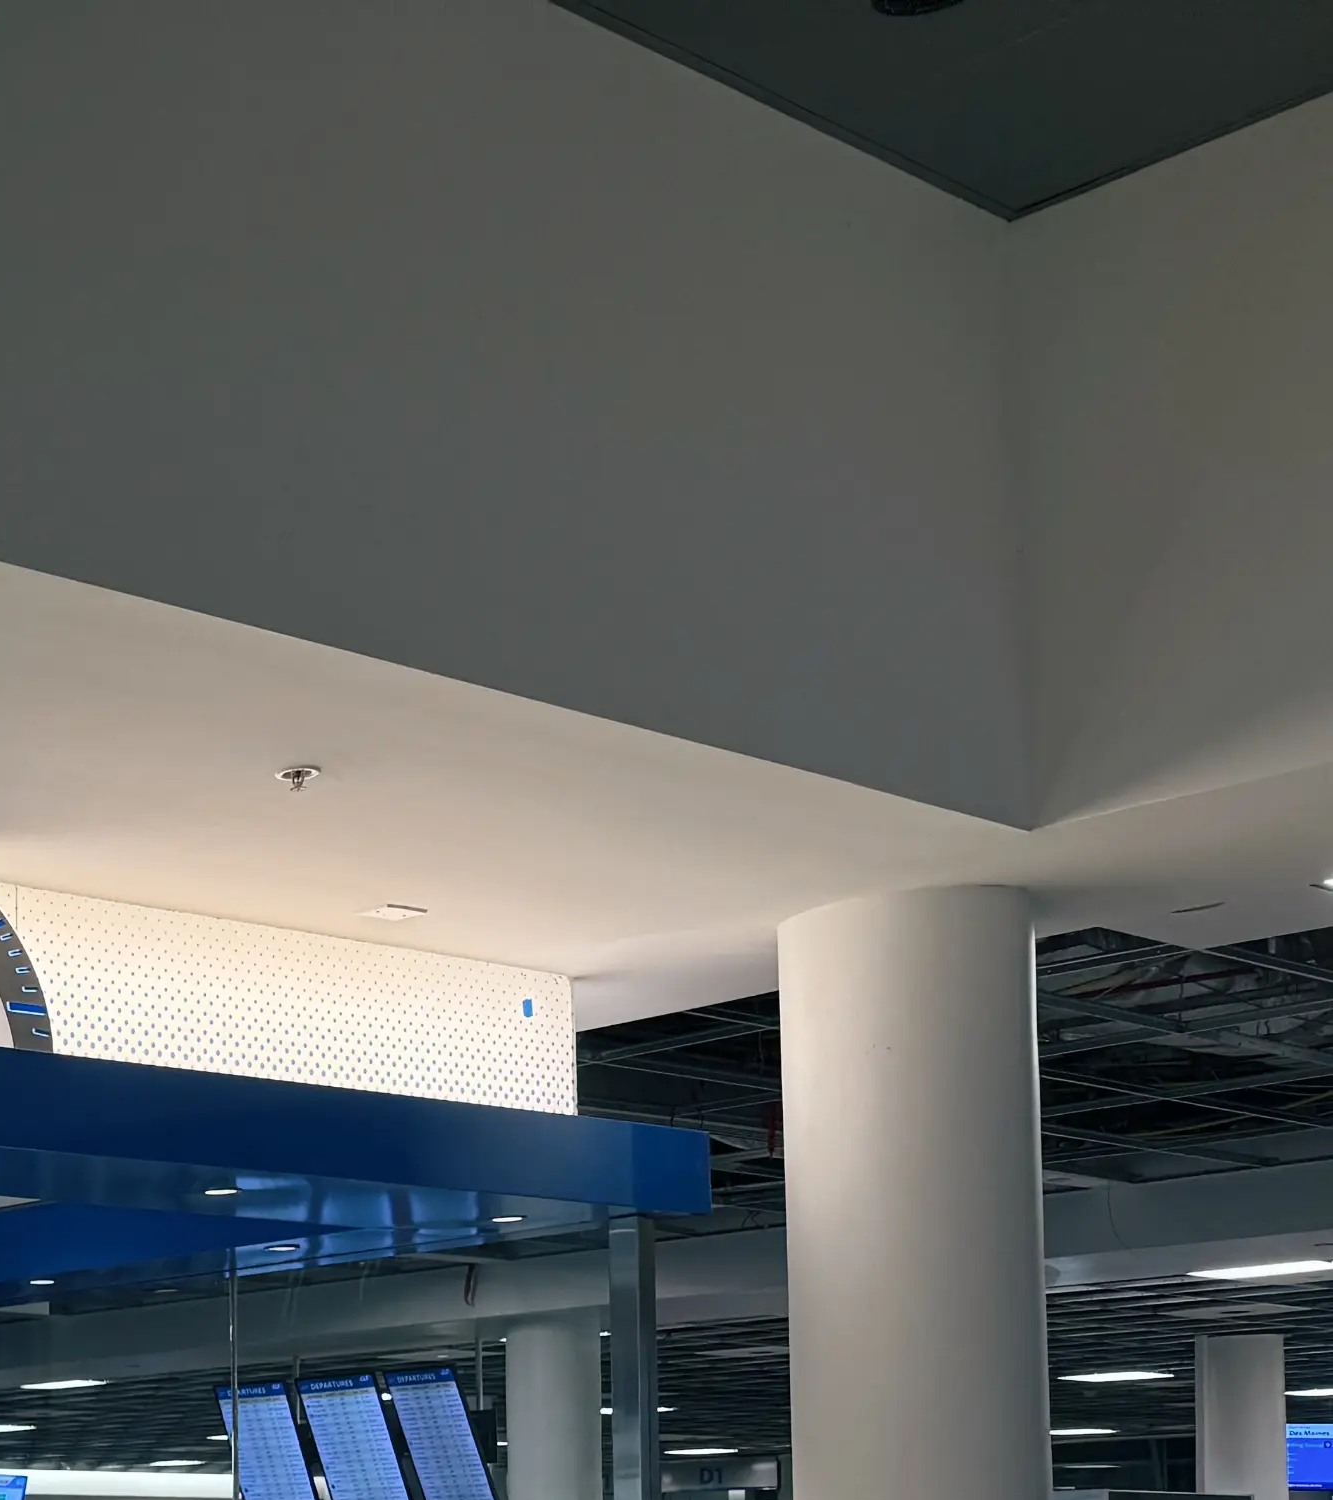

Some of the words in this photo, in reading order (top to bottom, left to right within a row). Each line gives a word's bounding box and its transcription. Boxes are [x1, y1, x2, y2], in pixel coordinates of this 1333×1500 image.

[396, 1373, 436, 1383] DEPARTURES
[310, 1379, 354, 1390] DEPARTURES
[227, 1387, 266, 1397] DARTURES
[699, 1467, 724, 1485] D1
